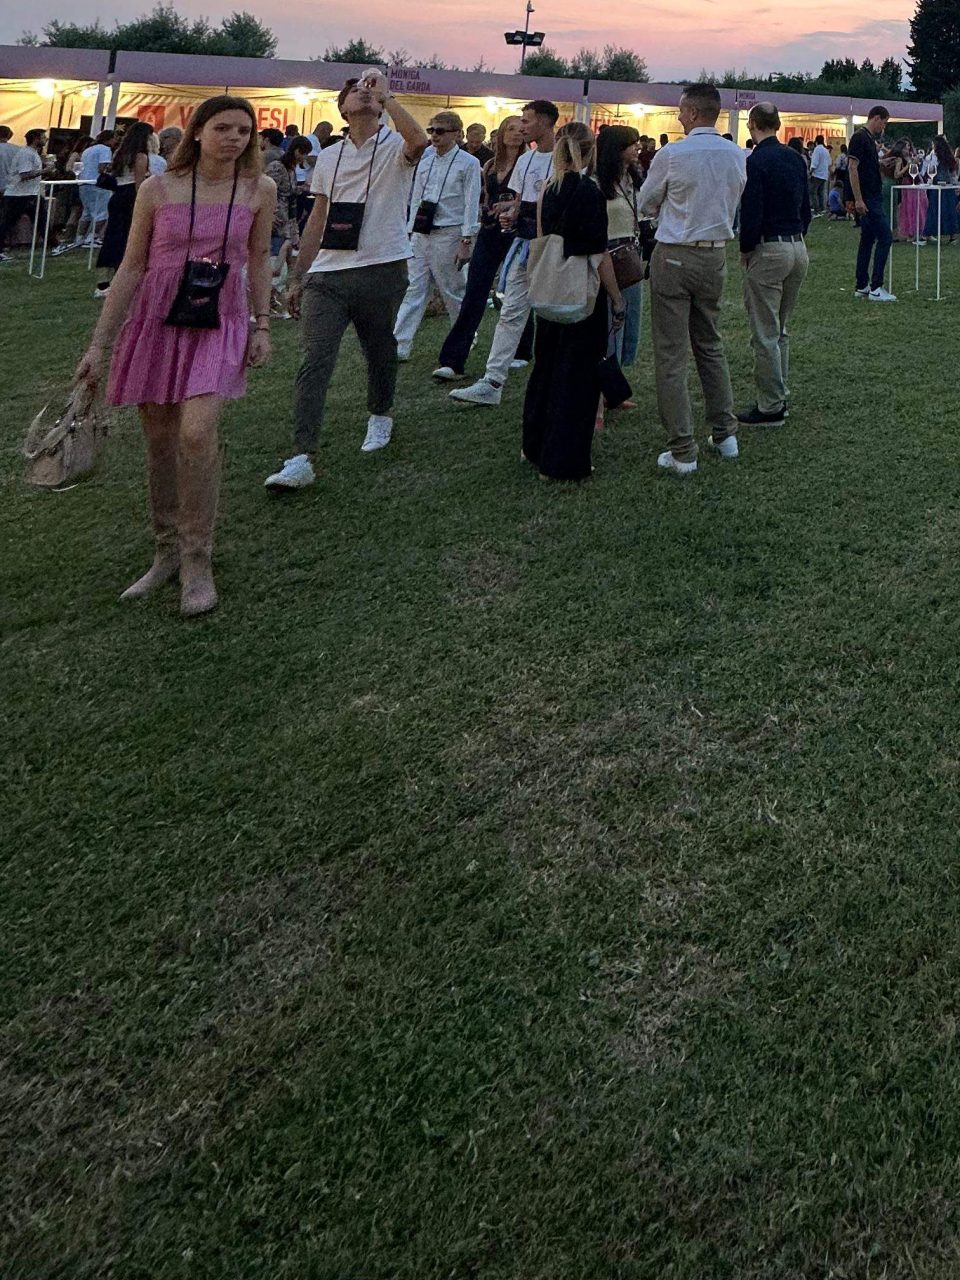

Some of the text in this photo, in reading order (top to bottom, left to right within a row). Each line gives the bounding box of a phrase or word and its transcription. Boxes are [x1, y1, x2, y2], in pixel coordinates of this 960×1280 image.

[390, 68, 420, 80] MONIGA
[389, 80, 431, 92] DEL GARDA
